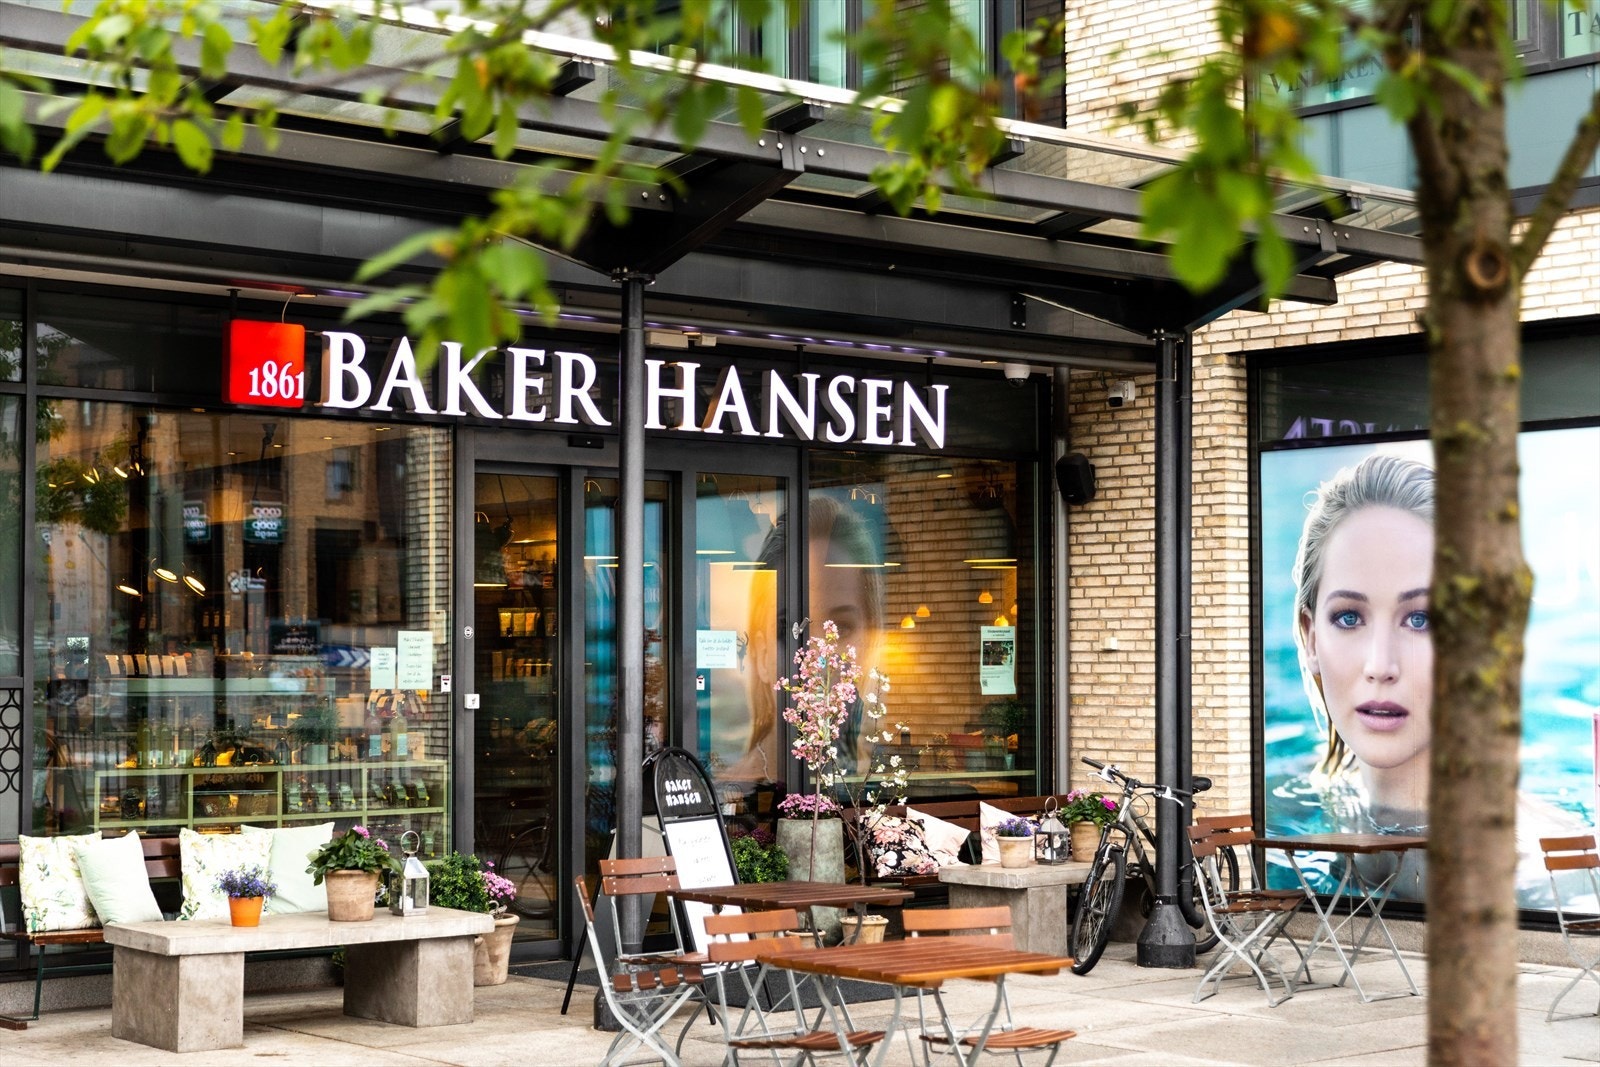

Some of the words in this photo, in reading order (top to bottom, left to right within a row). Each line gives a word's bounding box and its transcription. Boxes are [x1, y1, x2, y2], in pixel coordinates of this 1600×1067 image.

[248, 359, 305, 400] 1861
[321, 330, 612, 427] BAKER
[644, 359, 950, 450] HANSEN
